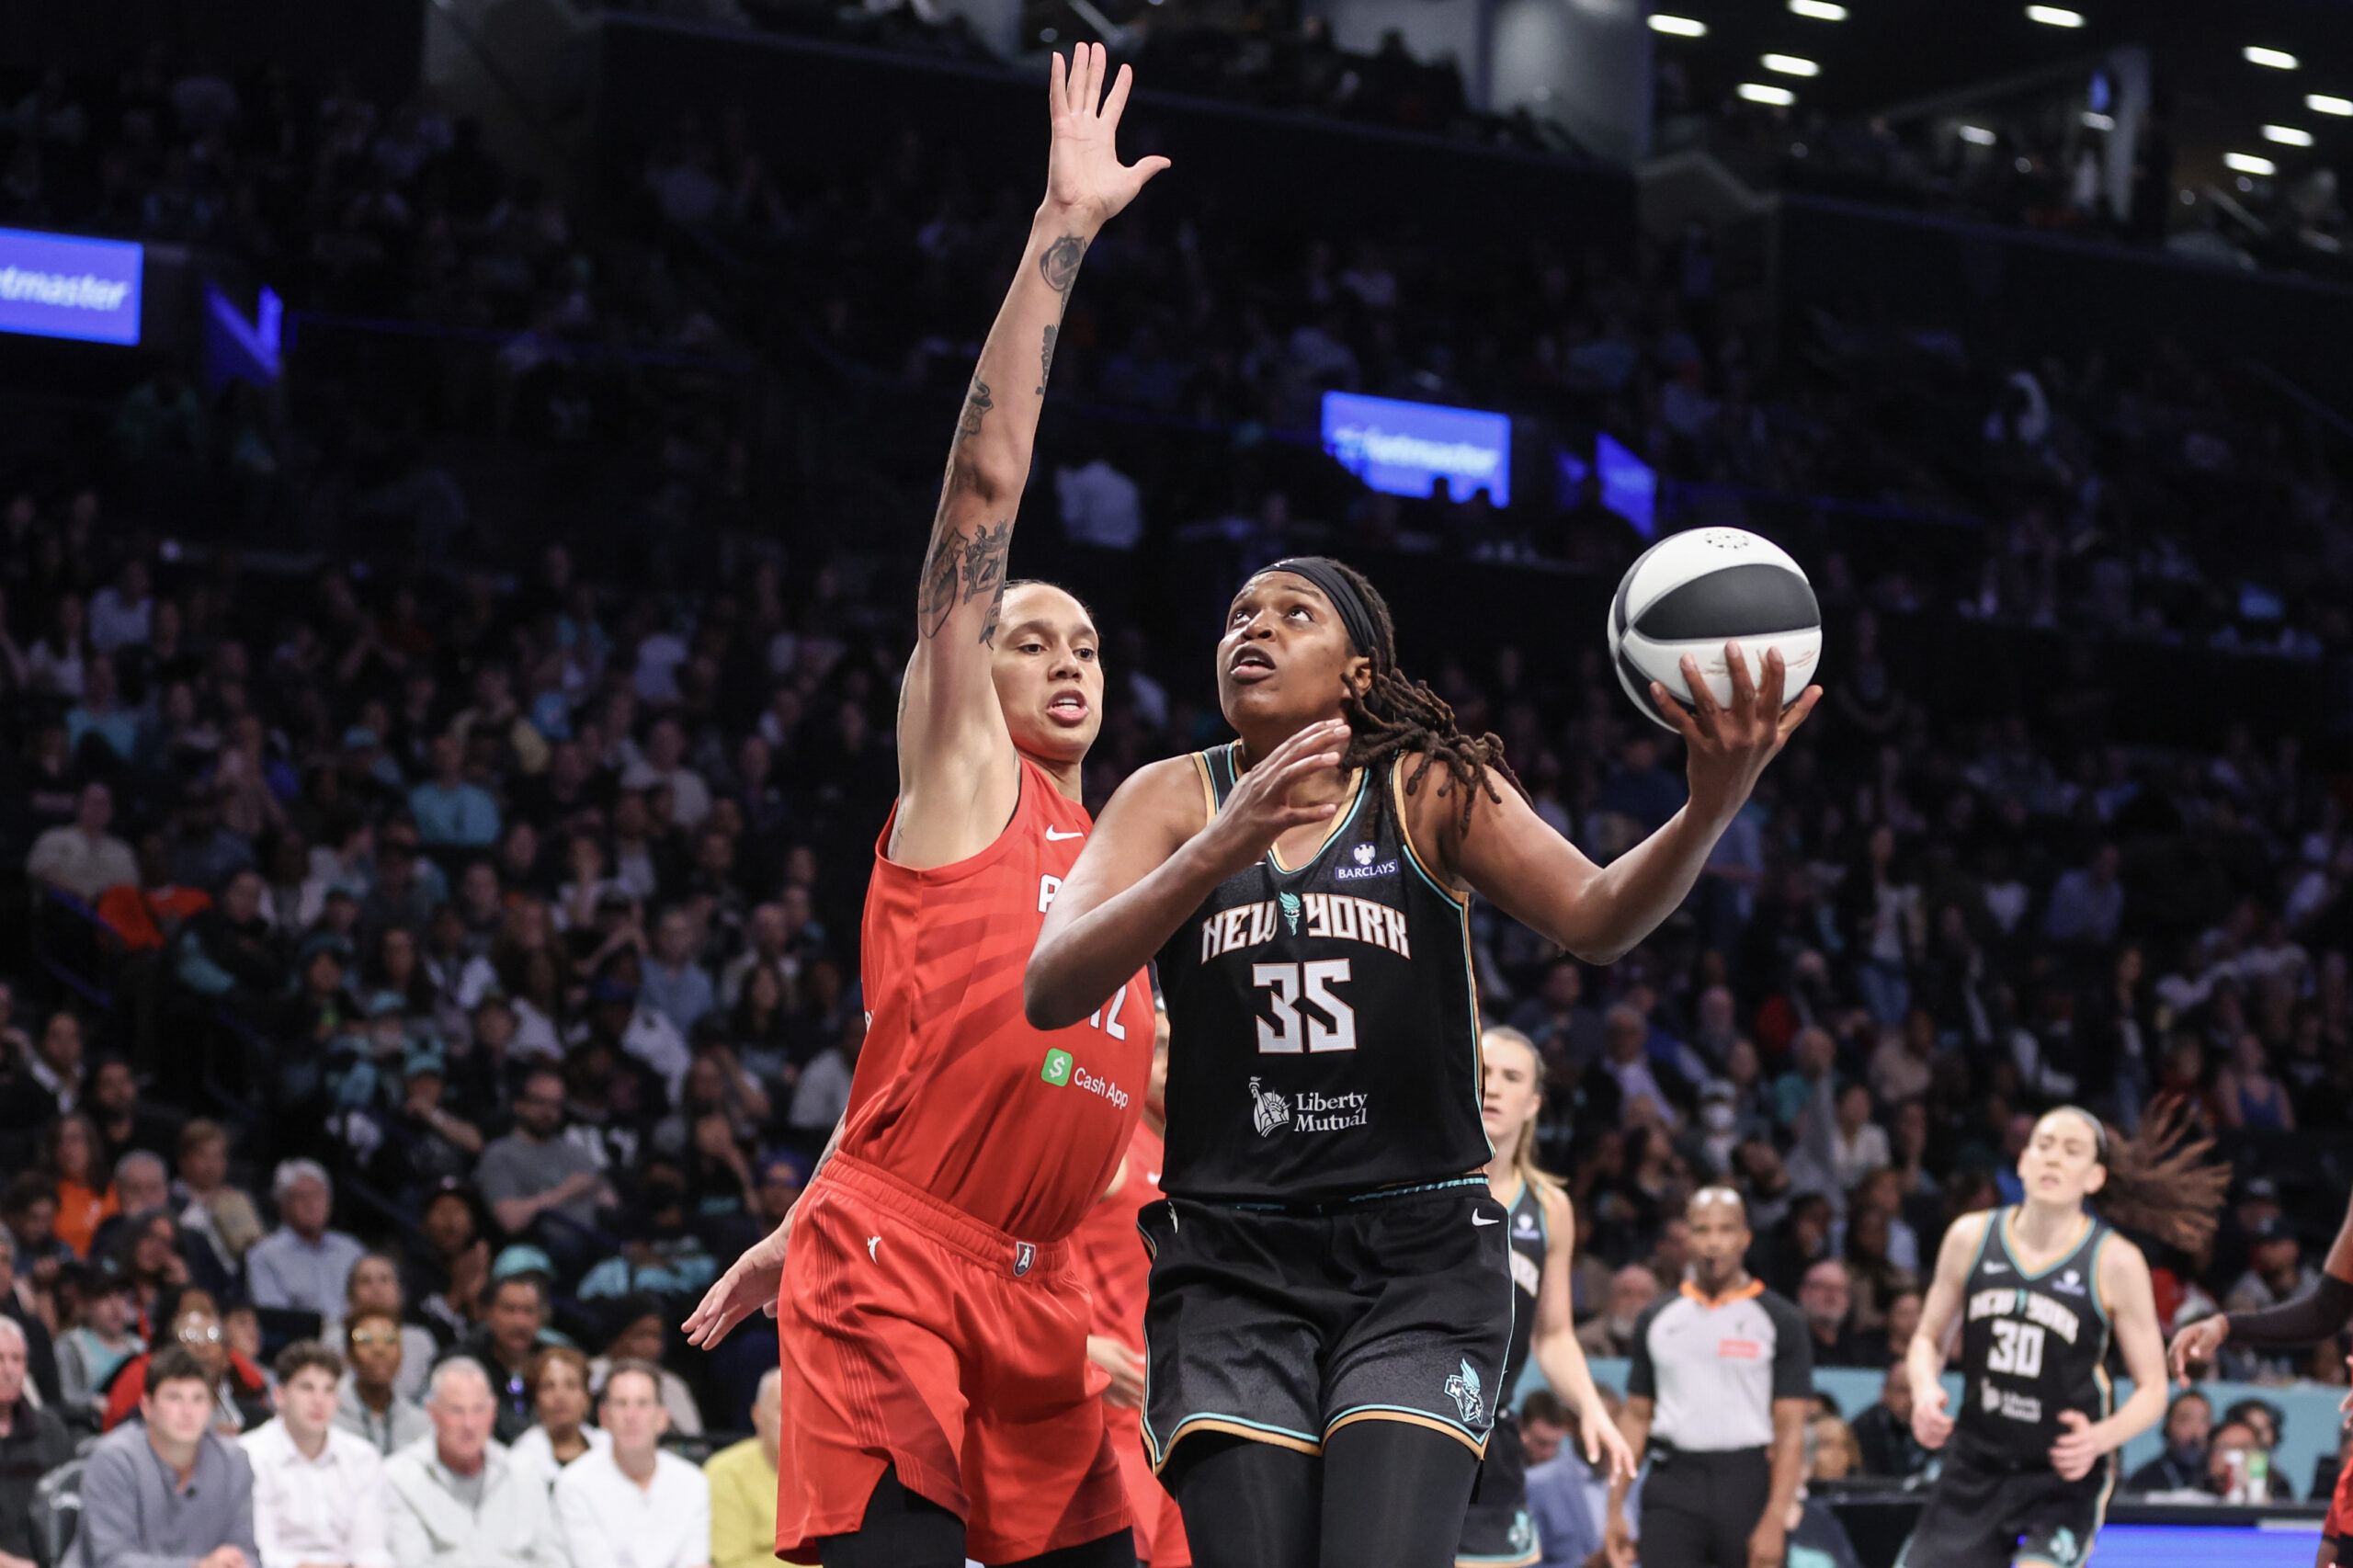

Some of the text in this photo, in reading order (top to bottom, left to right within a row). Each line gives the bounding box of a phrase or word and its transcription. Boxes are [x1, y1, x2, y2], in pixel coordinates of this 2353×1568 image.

[1337, 861, 1397, 880] BARCLAYS
[1200, 893, 1412, 965] NEW YORK
[1252, 958, 1358, 1054] 35
[1074, 1067, 1106, 1096] Cash
[1107, 1083, 1129, 1109] App
[1296, 1091, 1369, 1115] Liberty
[1293, 1107, 1369, 1132] Mutual
[1987, 1317, 2045, 1379] 30
